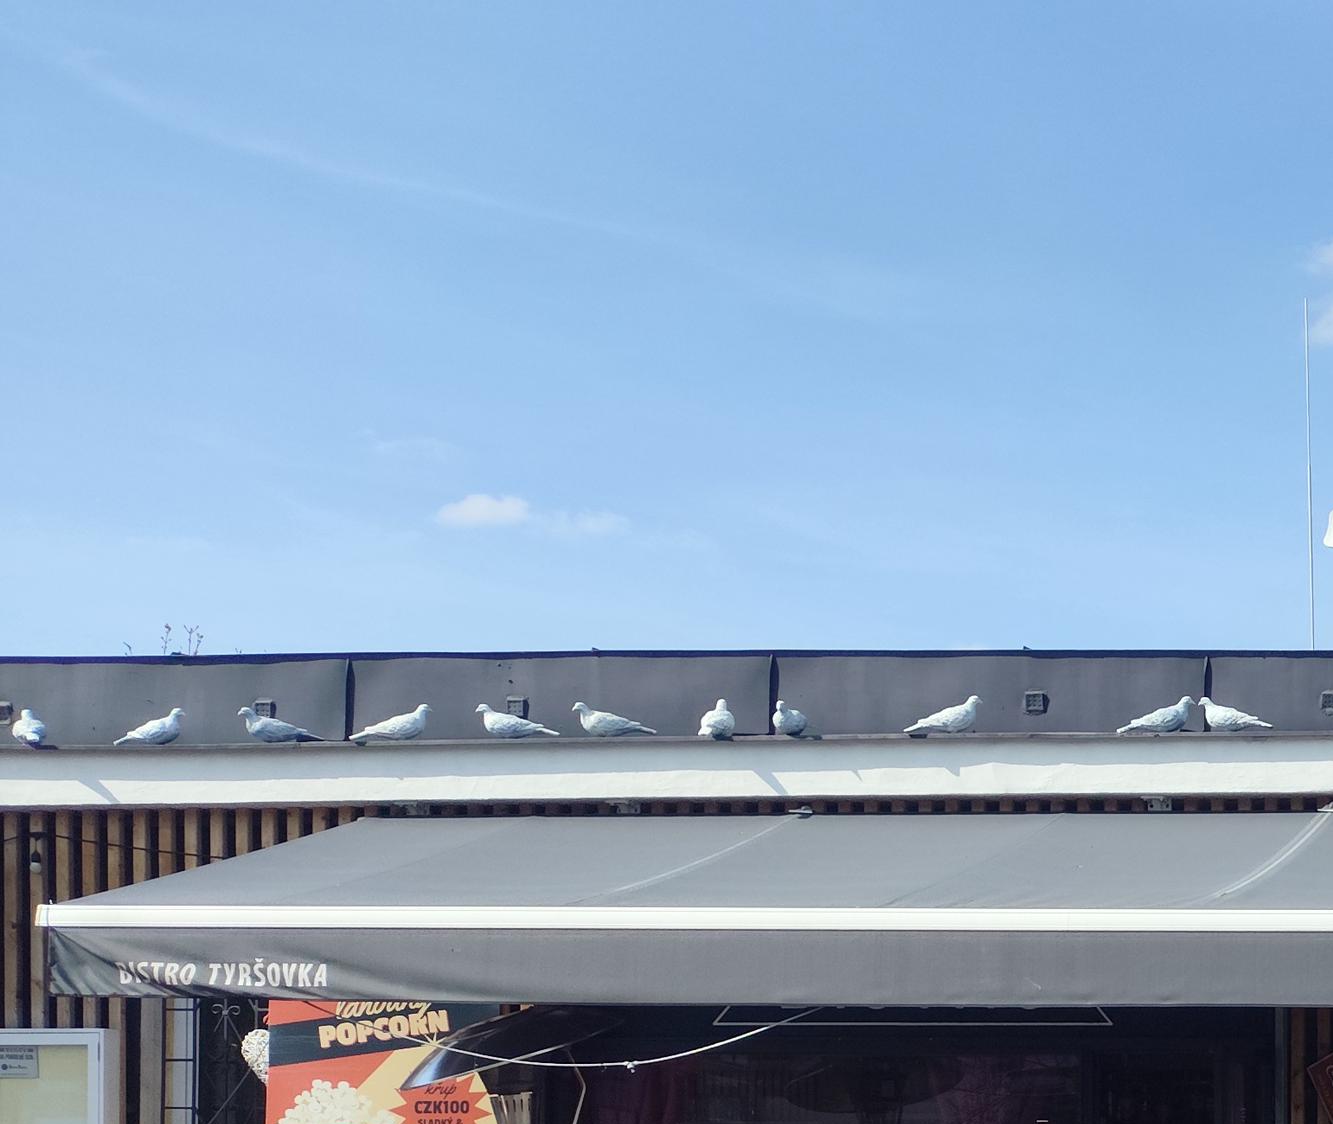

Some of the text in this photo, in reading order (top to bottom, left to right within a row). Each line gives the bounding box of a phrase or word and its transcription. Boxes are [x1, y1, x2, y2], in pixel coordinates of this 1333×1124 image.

[116, 958, 328, 987] BISTRO TYRŠOVKA
[318, 1009, 450, 1049] POPCORN
[414, 1101, 469, 1114] CZK100
